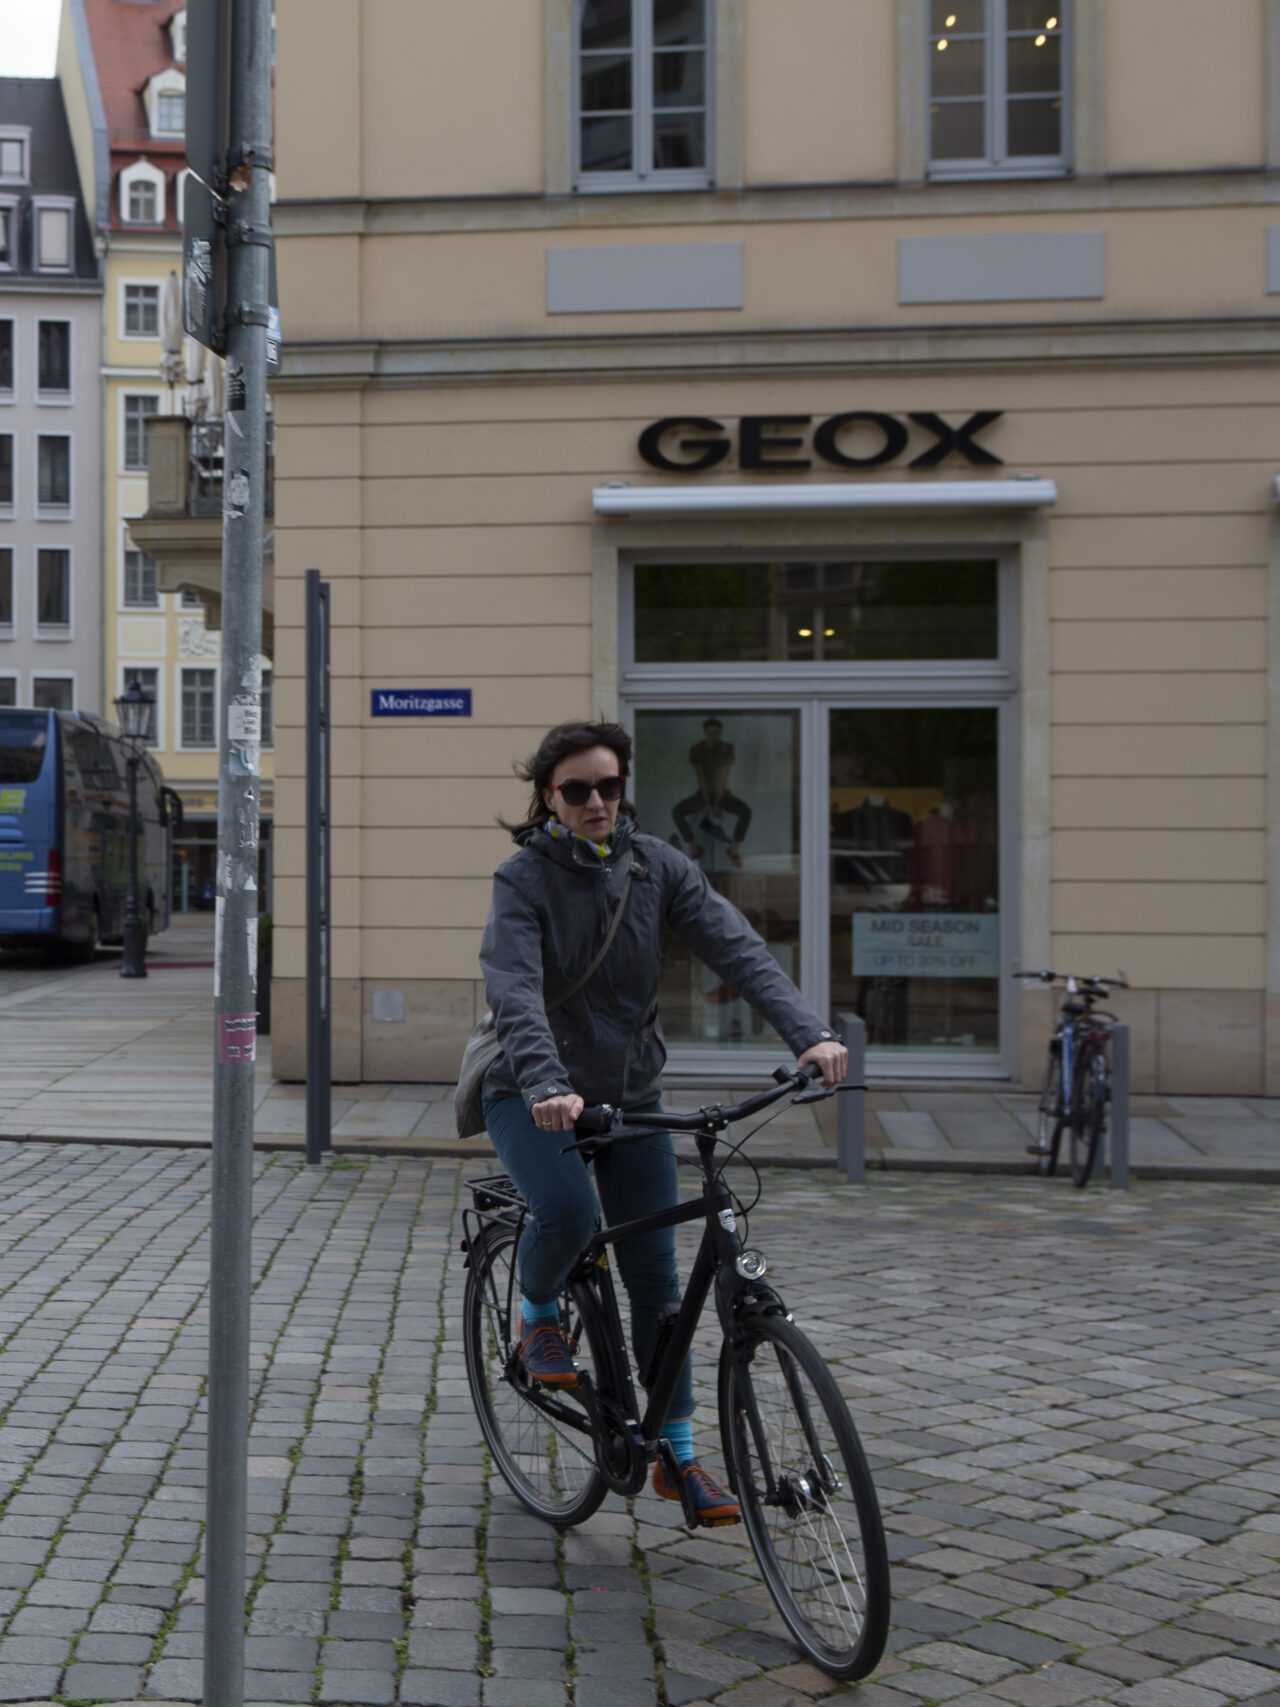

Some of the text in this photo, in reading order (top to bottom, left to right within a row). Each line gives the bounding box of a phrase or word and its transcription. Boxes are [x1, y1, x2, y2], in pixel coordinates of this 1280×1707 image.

[638, 410, 1004, 472] GEOX
[379, 694, 464, 712] Moritzgasse
[871, 919, 980, 933] MID SEASON
[906, 935, 945, 948] SALE
[873, 955, 893, 967] UP
[896, 955, 914, 967] TO
[950, 955, 977, 967] OFF
